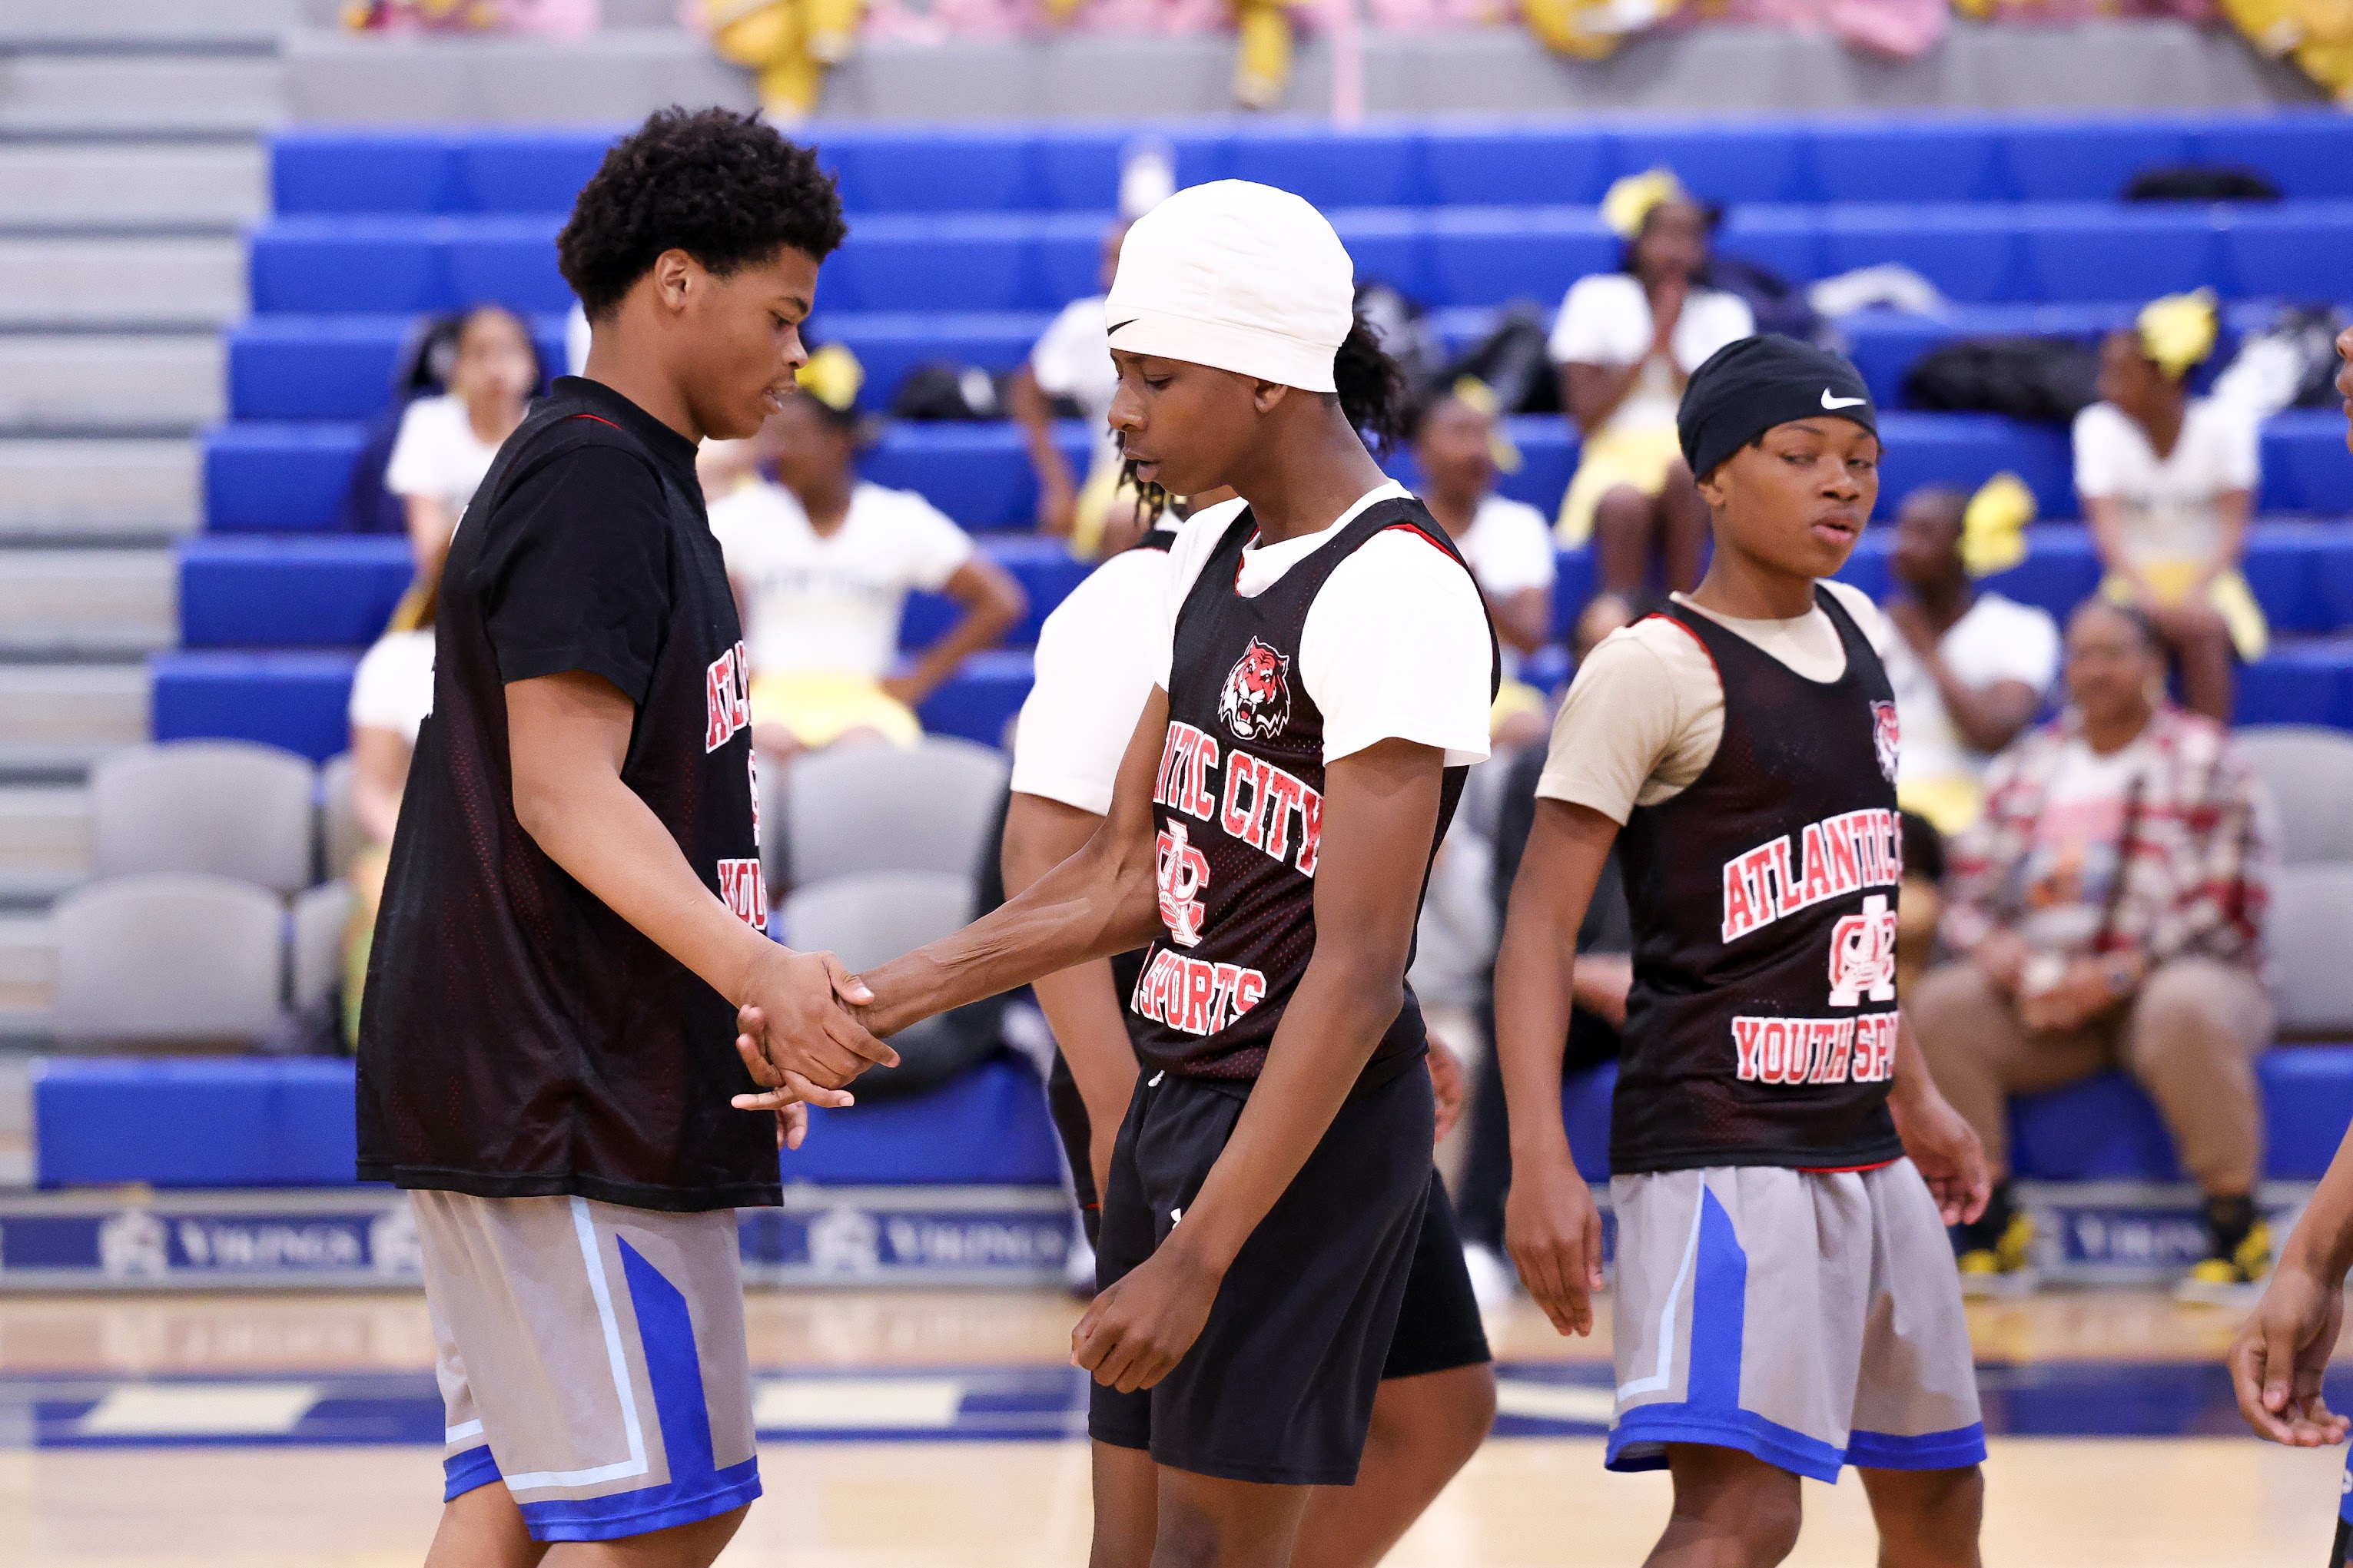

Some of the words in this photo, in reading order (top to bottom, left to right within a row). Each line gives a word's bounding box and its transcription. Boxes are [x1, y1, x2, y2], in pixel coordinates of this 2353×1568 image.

[1220, 748, 1324, 878] CITY
[1721, 808, 1897, 944] ATLANTIC
[1140, 947, 1267, 1036] SPORTS
[1731, 1016, 1855, 1084] YOUTH
